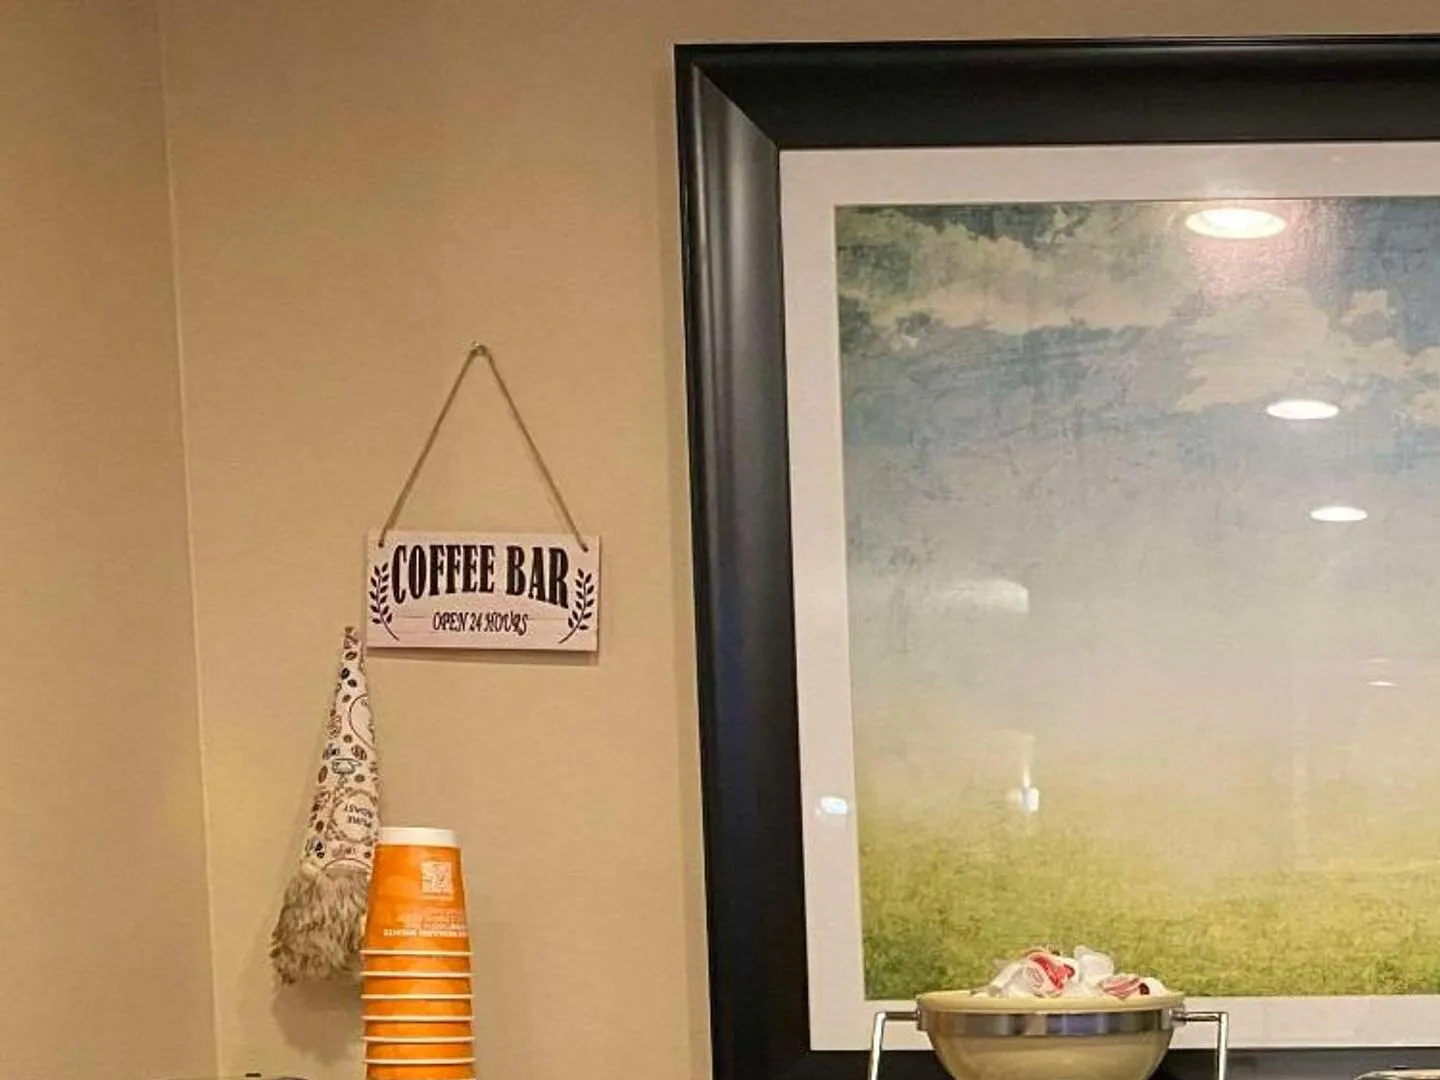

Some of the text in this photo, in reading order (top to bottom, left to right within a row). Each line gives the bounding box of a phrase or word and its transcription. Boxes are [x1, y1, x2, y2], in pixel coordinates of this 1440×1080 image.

[391, 544, 569, 609] COFFEE BAR
[432, 611, 529, 636] OPEN 24 HOURS
